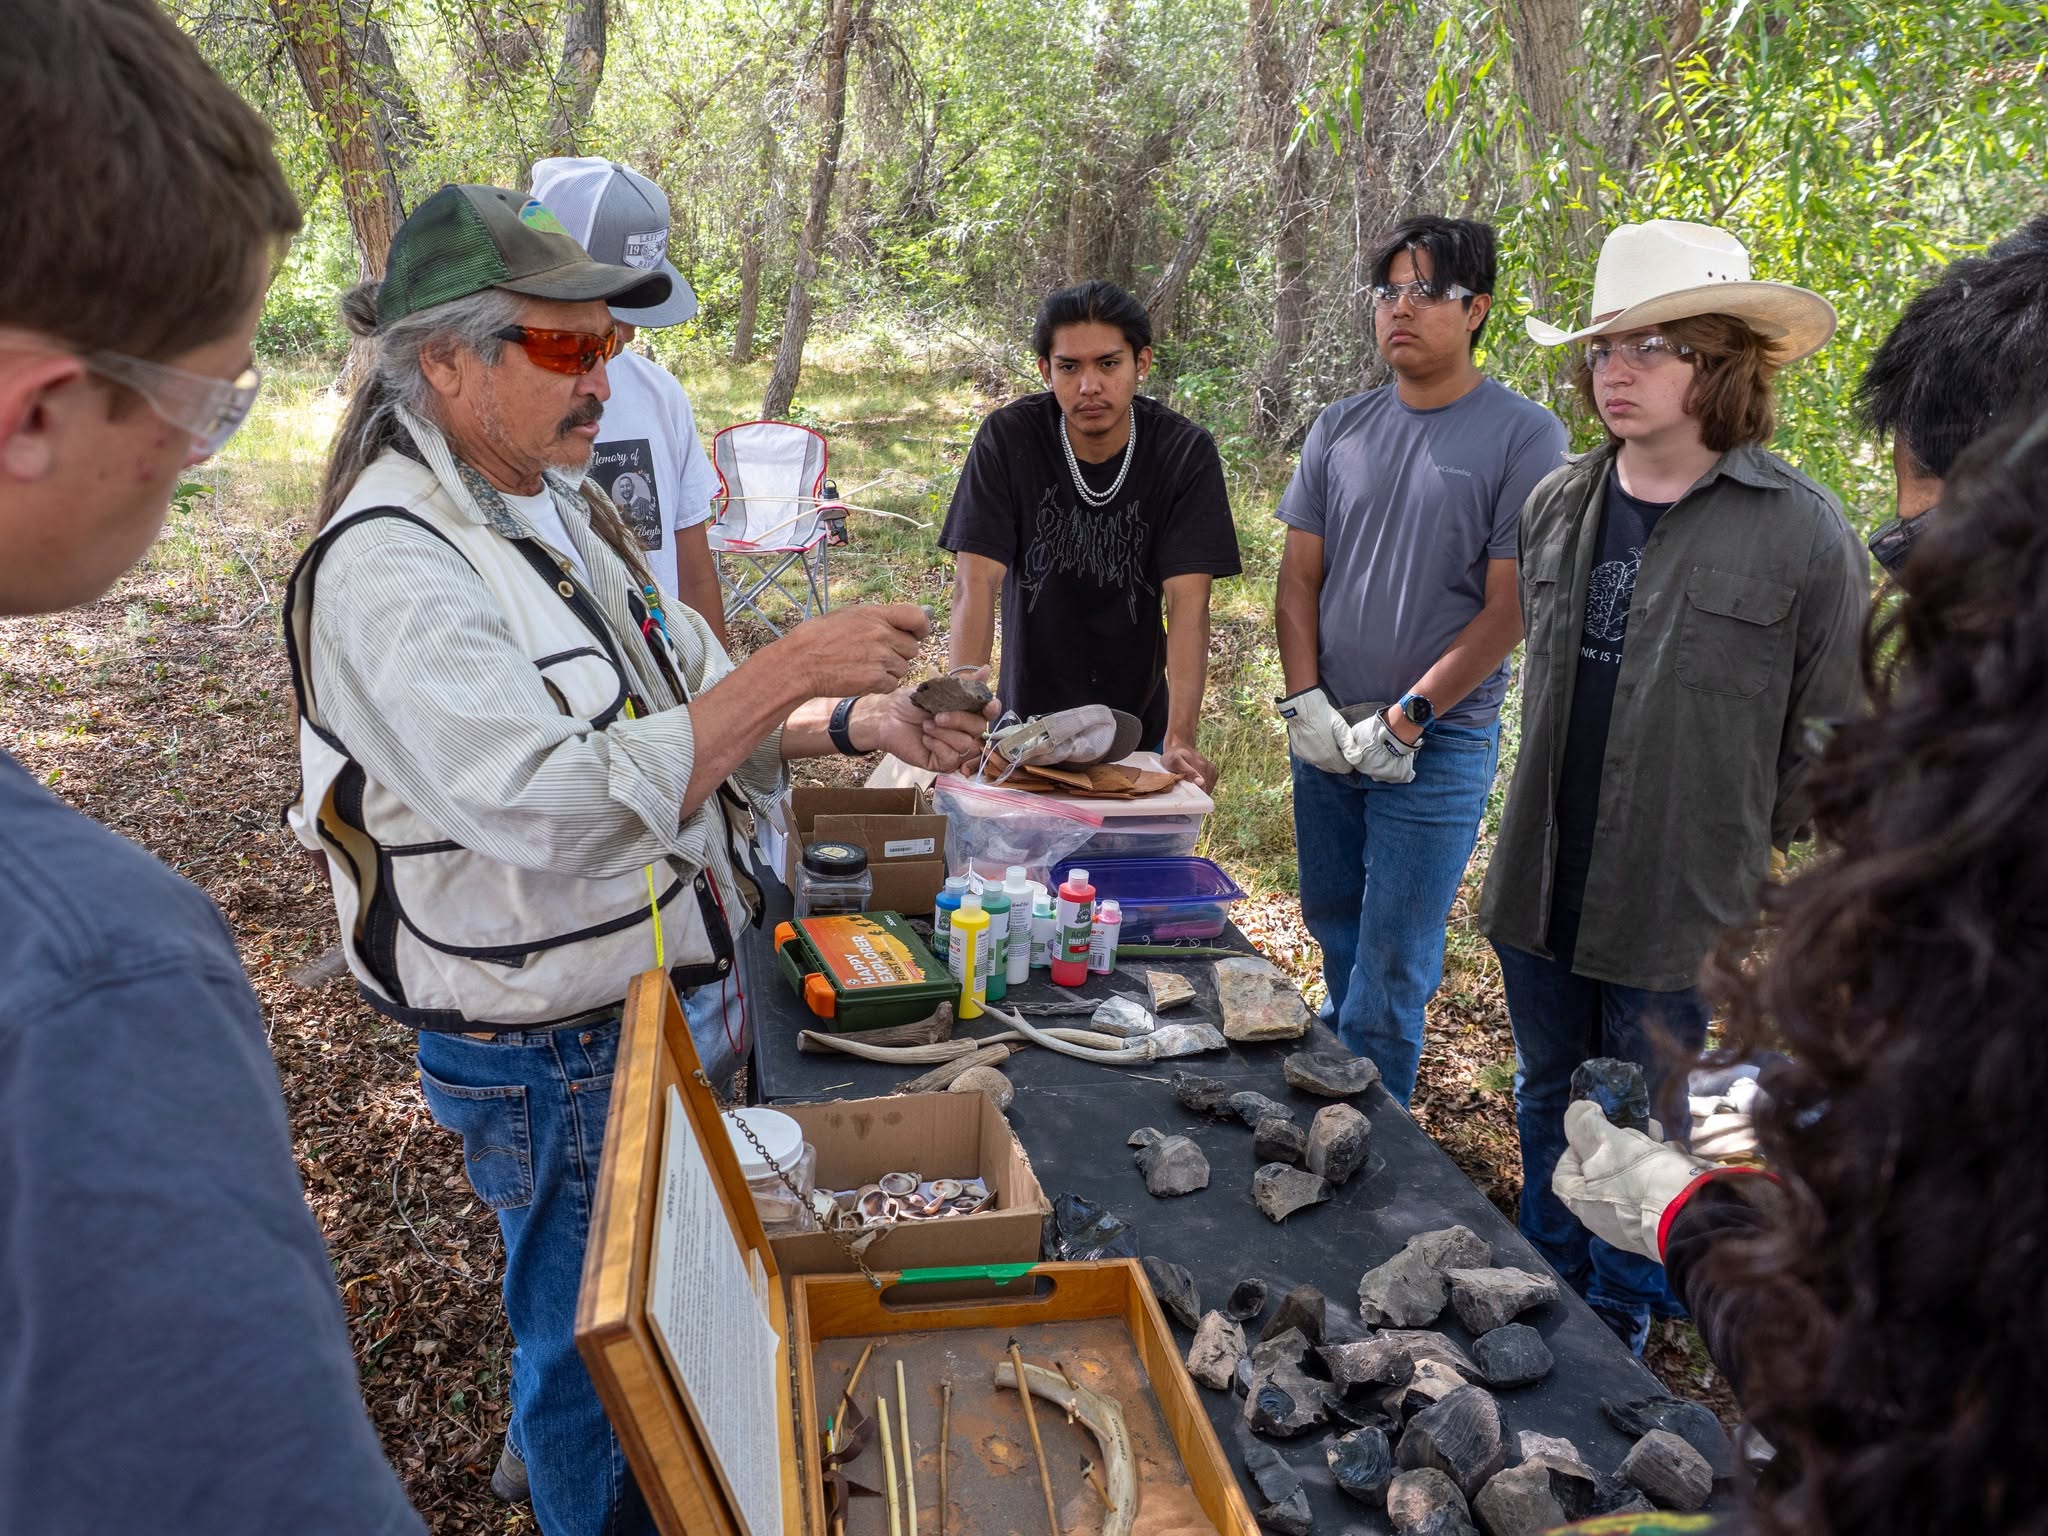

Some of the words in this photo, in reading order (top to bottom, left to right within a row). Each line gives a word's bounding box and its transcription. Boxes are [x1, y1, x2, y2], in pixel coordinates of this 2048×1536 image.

[629, 245, 640, 255] 19
[630, 448, 640, 466] of
[1442, 465, 1471, 477] Columbia
[1599, 650, 1611, 662] IS
[851, 935, 897, 983] EXPLORER
[880, 950, 895, 961] AID
[844, 954, 878, 985] HAPPY
[888, 962, 909, 981] FIRST
